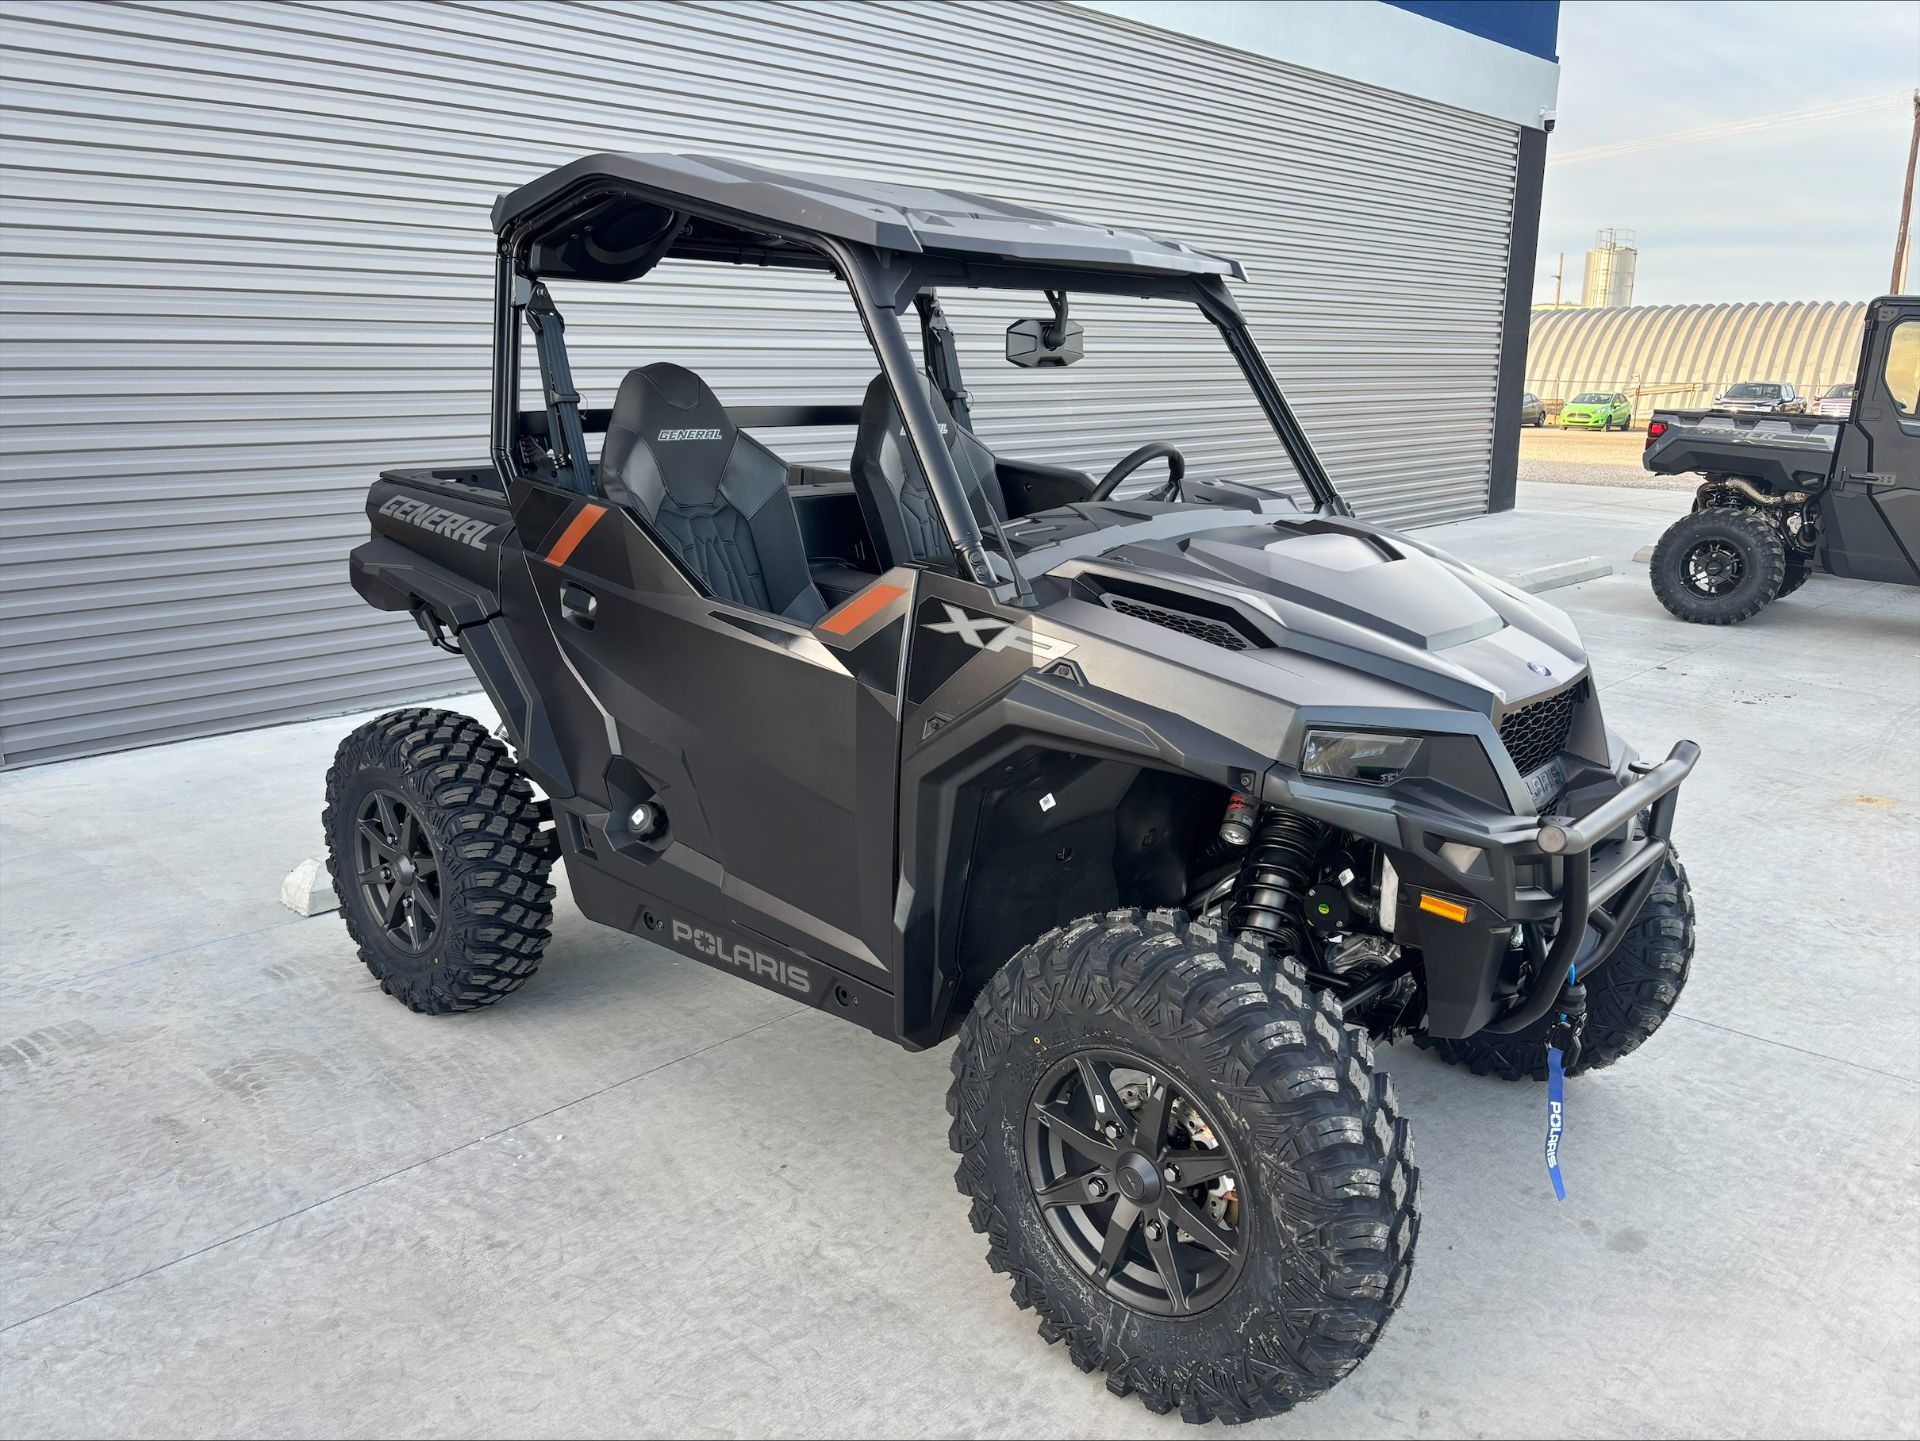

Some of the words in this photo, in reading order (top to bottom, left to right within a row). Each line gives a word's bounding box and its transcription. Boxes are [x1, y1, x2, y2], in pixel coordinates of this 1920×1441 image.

[658, 429, 722, 441] GENERAL
[379, 495, 497, 551] GENERAL
[920, 602, 1079, 661] XP
[1525, 764, 1563, 797] LARIS
[672, 919, 811, 993] POLARIS
[1546, 1101, 1561, 1169] POLARIS
